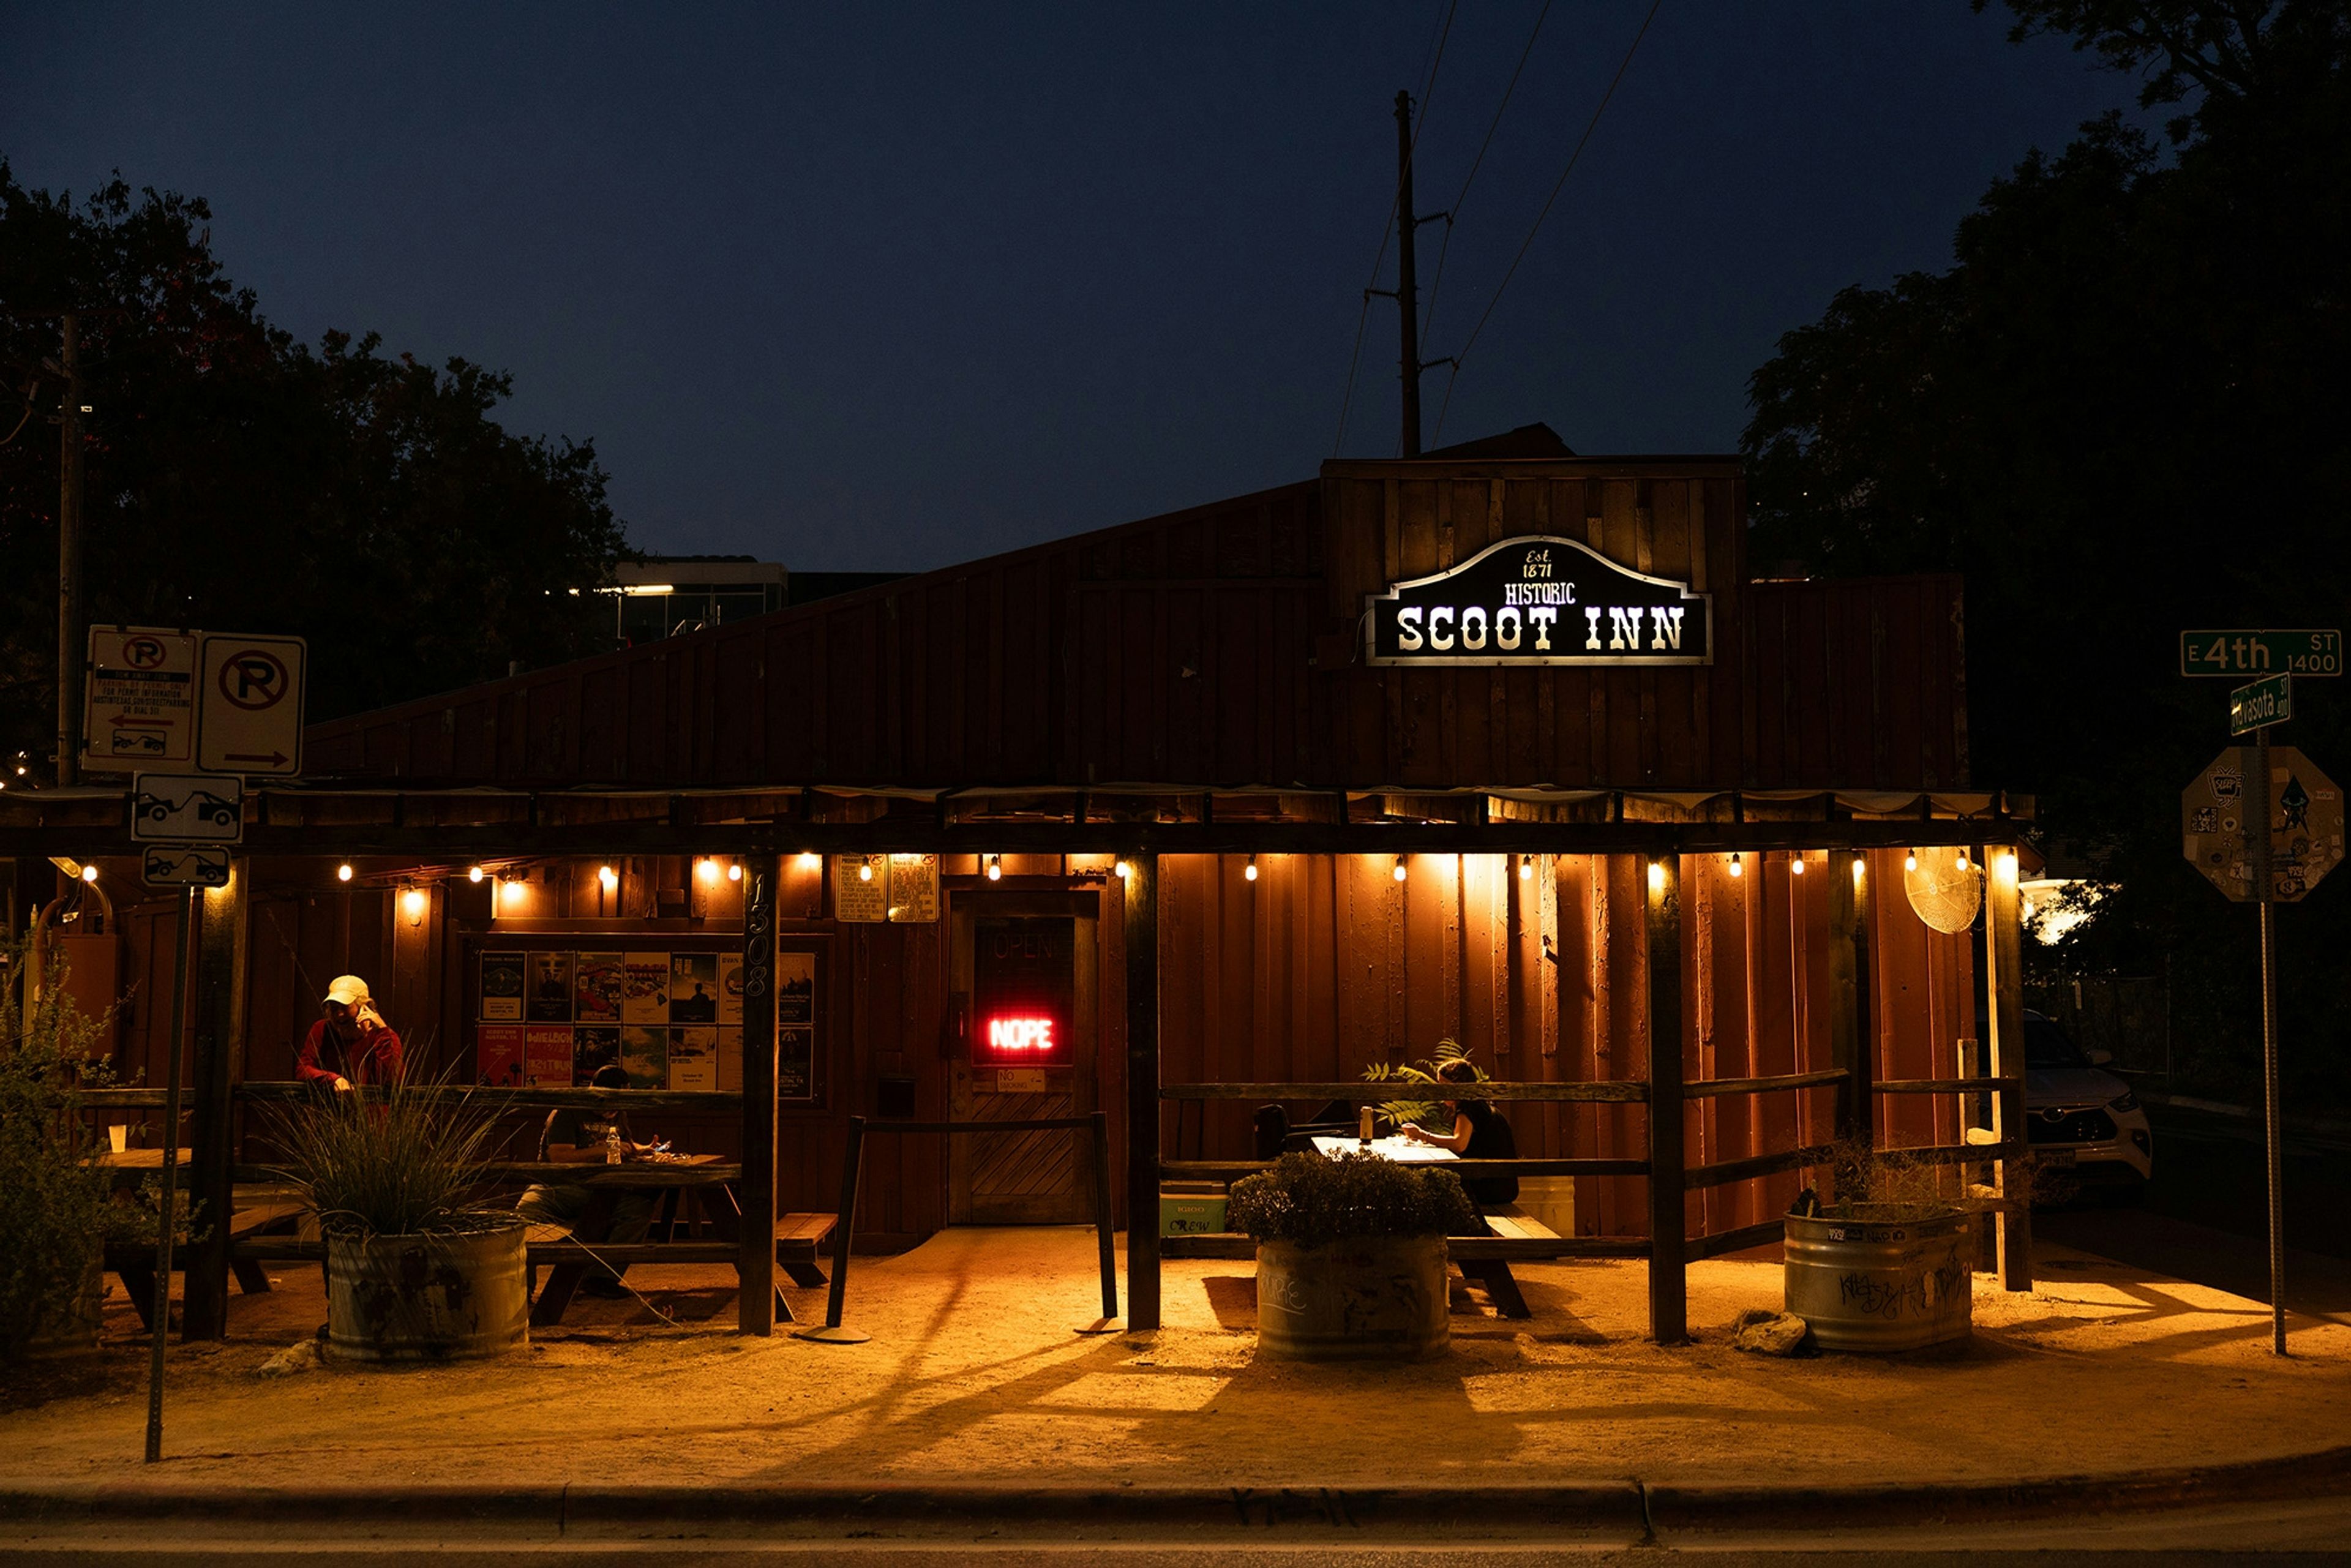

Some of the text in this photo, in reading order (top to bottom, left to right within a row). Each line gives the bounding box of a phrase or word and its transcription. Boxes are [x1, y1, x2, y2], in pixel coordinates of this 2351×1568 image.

[1526, 550, 1551, 563] Est.
[1523, 564, 1551, 578] 1871
[1505, 583, 1575, 605] HISTORIC
[1398, 607, 1684, 650] SCOOT INN
[2188, 633, 2334, 669] E 4th ST
[2287, 654, 2335, 672] 1400
[103, 686, 181, 697] FOR PERMIT INFORMATION
[134, 706, 148, 715] DIAL
[746, 873, 770, 997] 1308
[994, 932, 1052, 959] OPEN
[989, 1019, 1053, 1049] NOPE
[1000, 1071, 1014, 1081] NO
[1169, 1219, 1210, 1231] CREW
